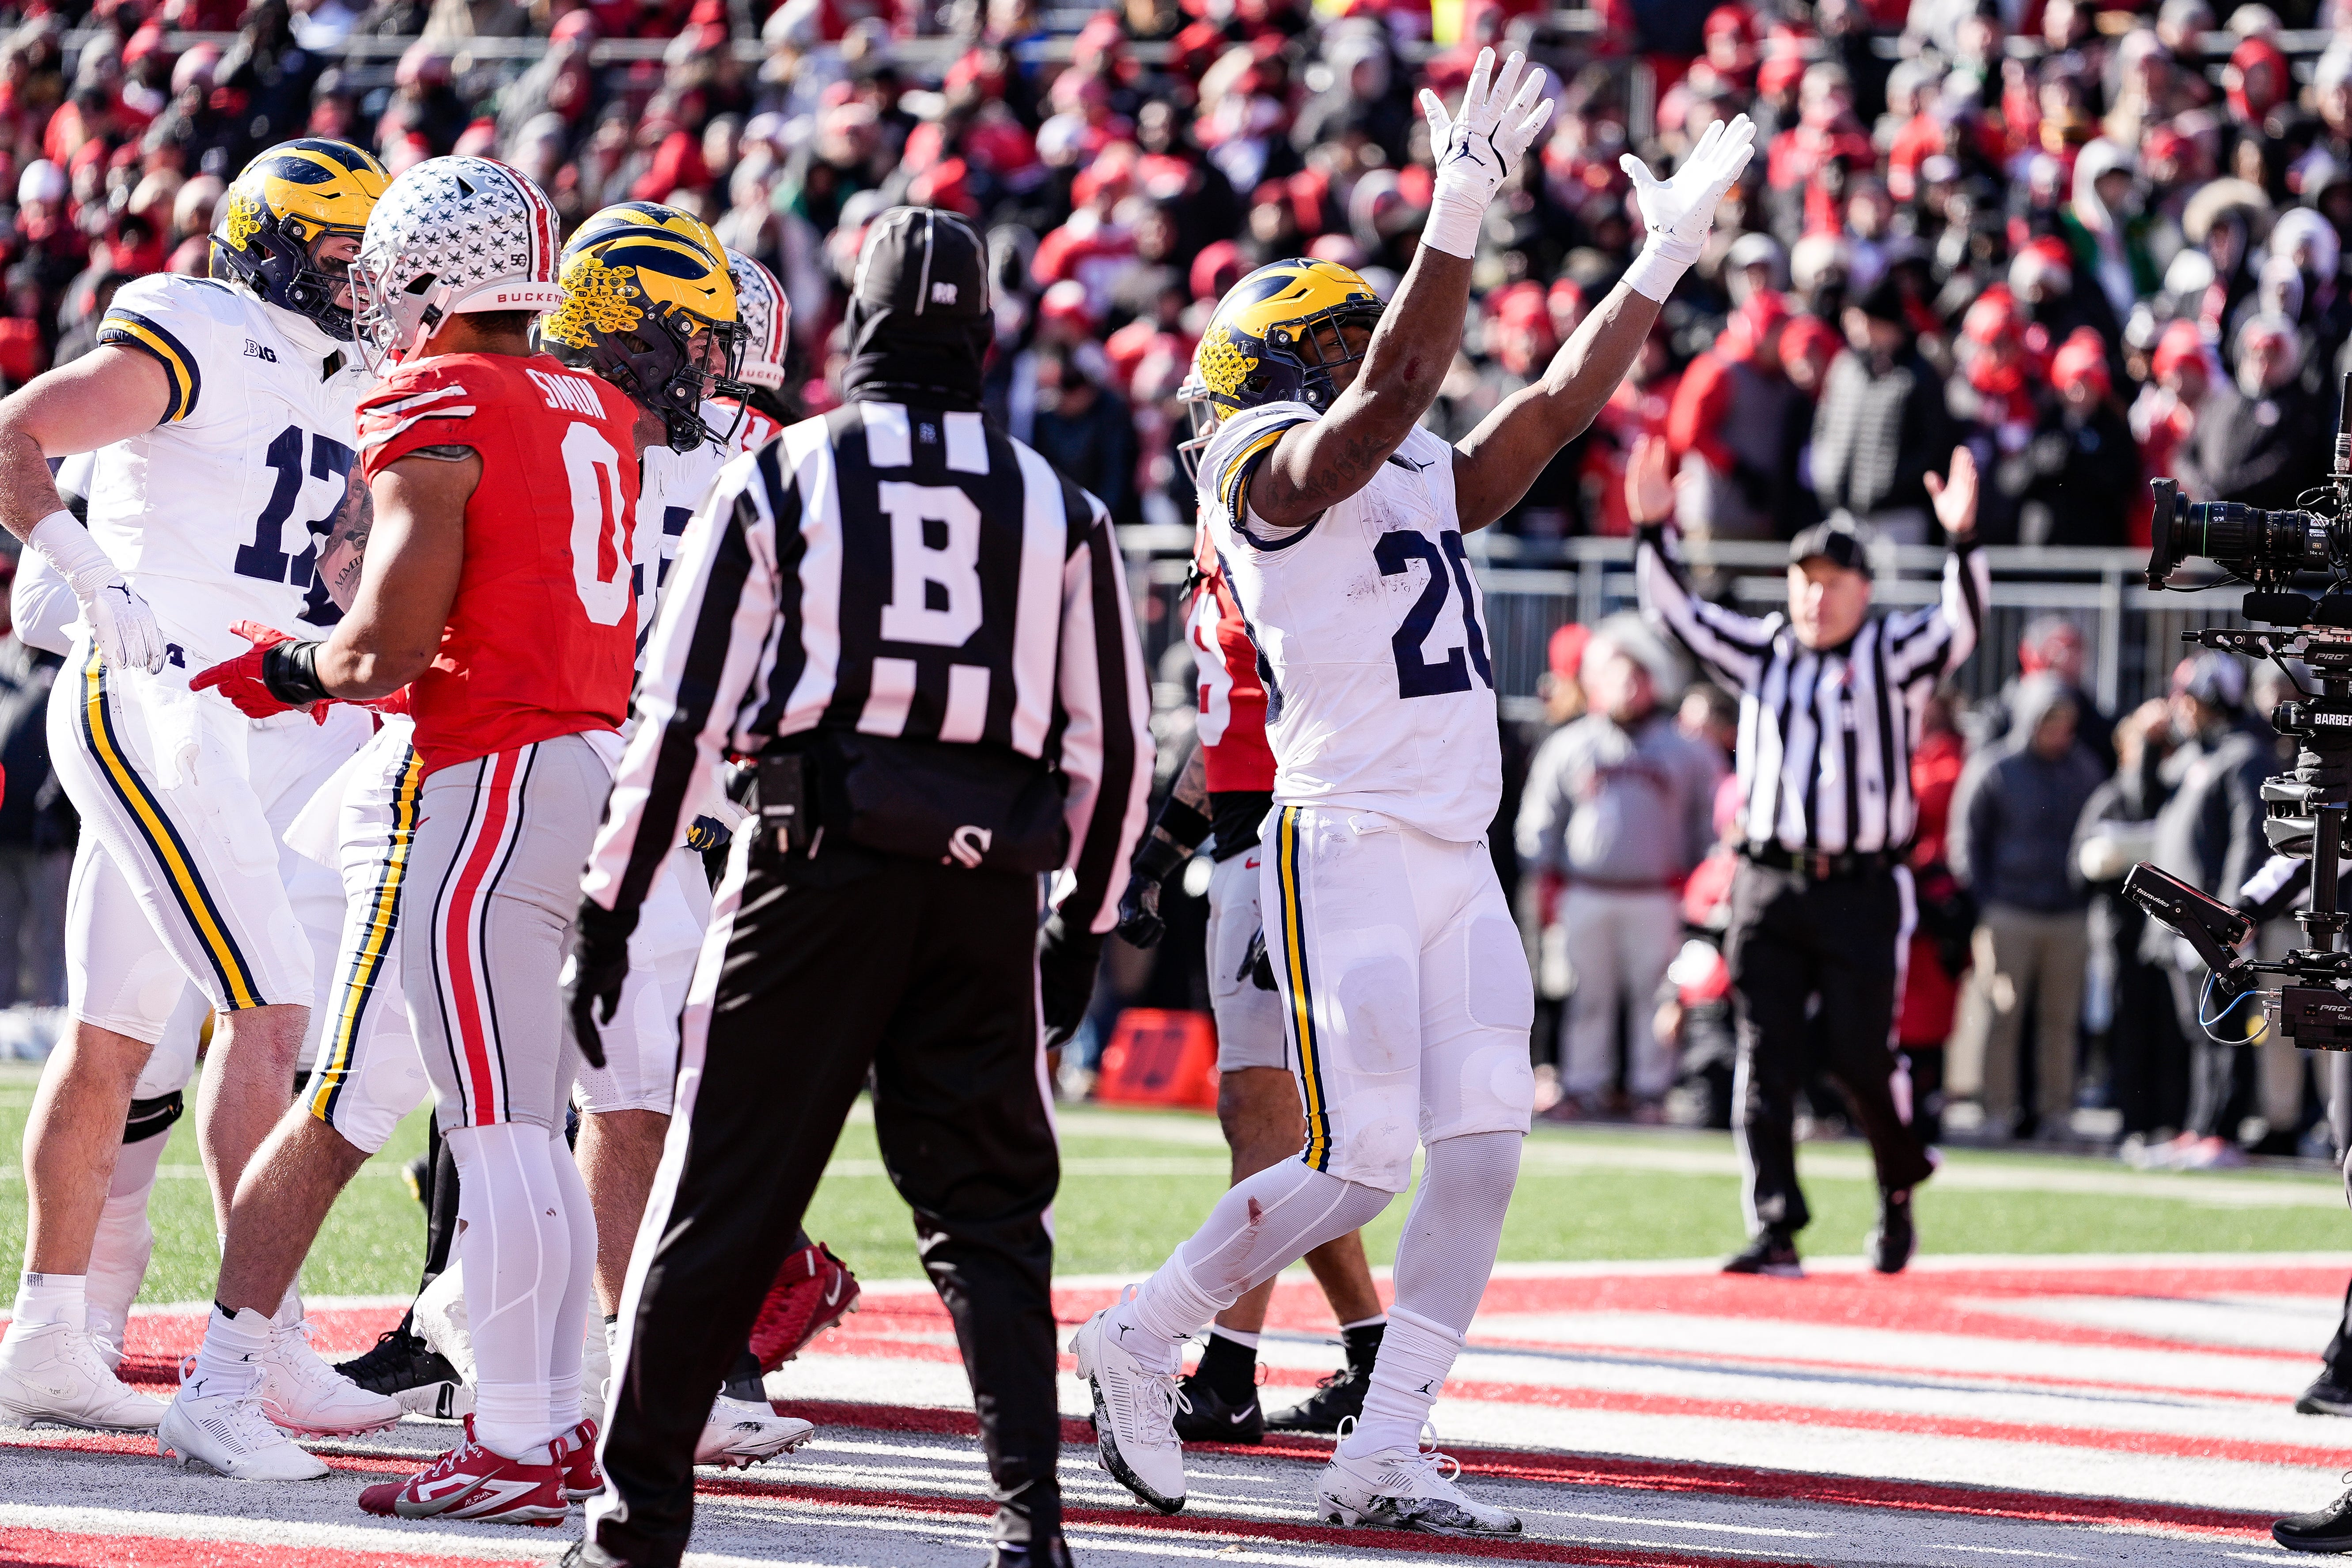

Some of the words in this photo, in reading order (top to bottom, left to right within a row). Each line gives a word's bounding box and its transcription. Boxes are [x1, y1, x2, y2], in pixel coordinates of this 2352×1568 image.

[525, 368, 607, 420] SIMON
[561, 421, 633, 626] 0
[878, 480, 984, 648] B
[1373, 530, 1495, 697] 20
[2136, 887, 2170, 907] transvideo
[465, 1491, 492, 1507] ALPHA
